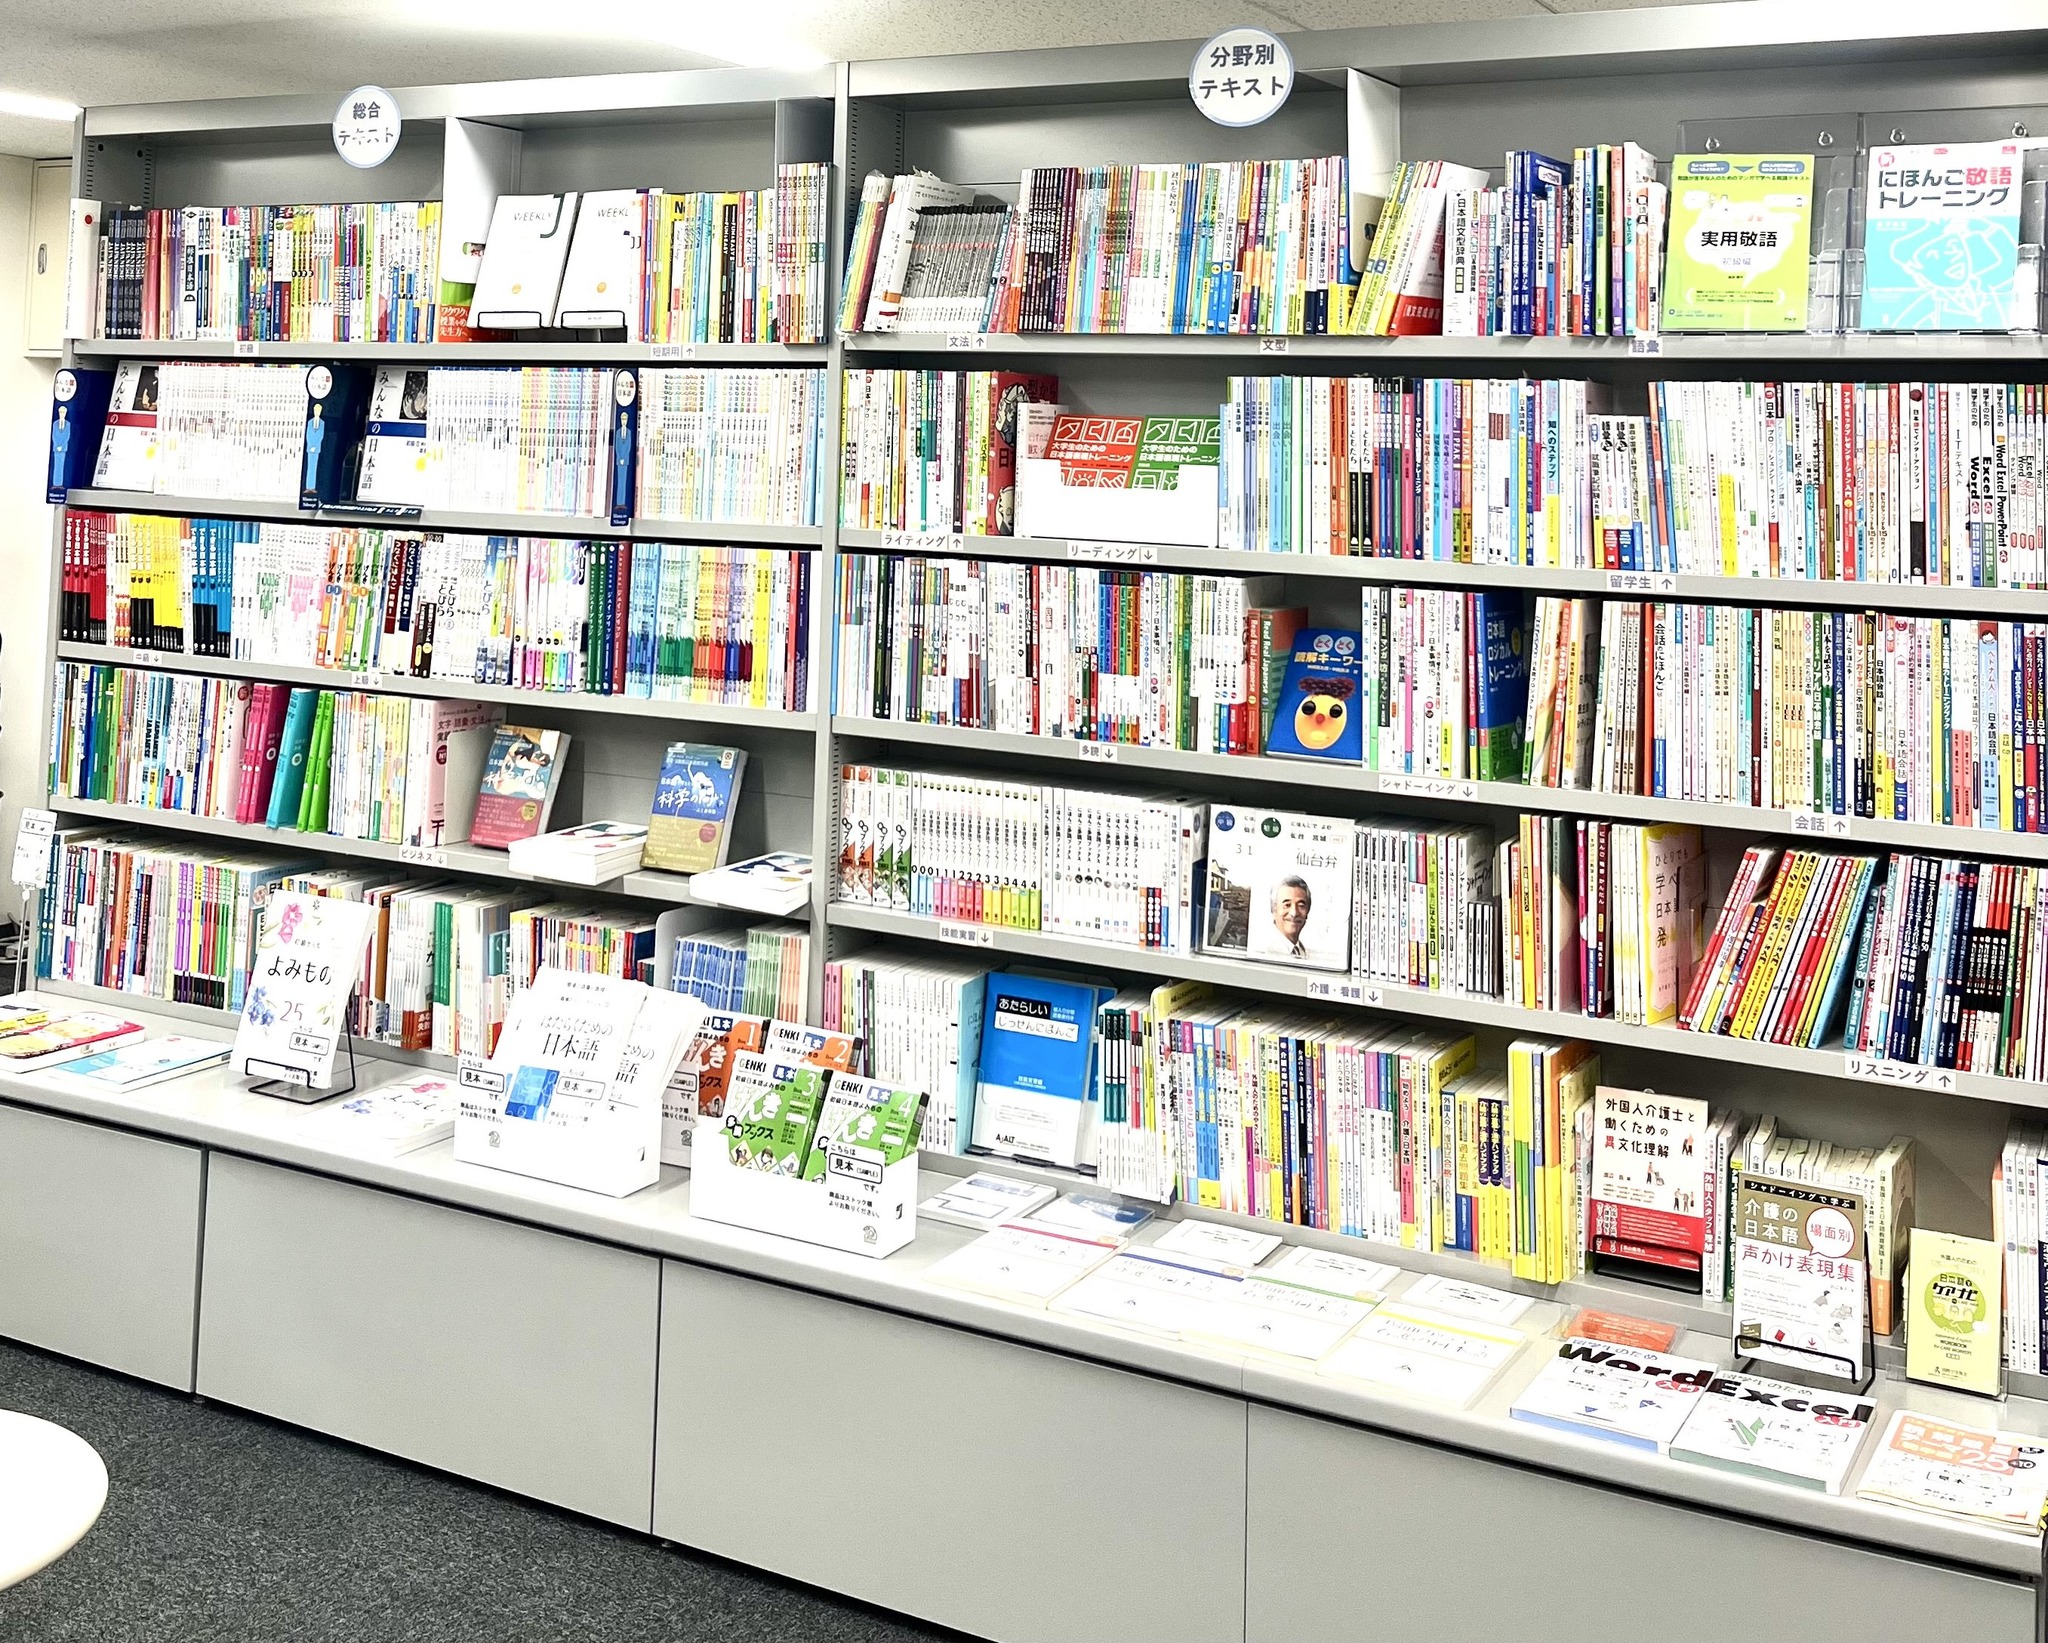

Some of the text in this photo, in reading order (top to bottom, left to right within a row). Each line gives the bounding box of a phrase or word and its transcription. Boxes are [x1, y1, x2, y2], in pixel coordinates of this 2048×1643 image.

[1209, 43, 1276, 69] 分野別
[1199, 76, 1284, 99] テキスト
[353, 101, 381, 120] 総合
[1878, 165, 2012, 188] にほんご敬語
[1878, 186, 2010, 209] トレーニング
[597, 207, 629, 218] WEEKL
[1701, 231, 1777, 248] 実用敬語
[949, 336, 969, 348] 文法
[1263, 339, 1286, 352] 文型
[1632, 339, 1659, 353] 語彙
[1996, 445, 2004, 465] Word
[1971, 456, 1980, 499] Word
[1982, 457, 1993, 499] Excel
[1998, 494, 2007, 547] PowerPoint
[885, 536, 946, 548] ライティング
[1071, 545, 1137, 561] リーディング
[1610, 575, 1651, 589] 留学生
[1487, 620, 1505, 639] 日本語
[1487, 646, 1511, 662] ロジカル
[1249, 655, 1258, 693] Japanese
[1262, 655, 1270, 694] Japanese
[1488, 660, 1523, 684] トレーニング
[1082, 745, 1099, 758] 多読
[1381, 779, 1456, 795] シャドーイング
[1795, 816, 1826, 832] 会話
[400, 849, 433, 862] ビジネス
[1296, 853, 1338, 869] 仙台弁
[1655, 849, 1689, 866] ひとりでも
[911, 865, 917, 873] 0
[920, 866, 926, 874] 0
[928, 867, 933, 875] 0
[936, 868, 939, 877] 1
[945, 869, 948, 878] 1
[952, 870, 956, 878] 1
[959, 871, 964, 879] 2
[967, 872, 972, 880] 2
[976, 873, 981, 882] 2
[985, 875, 990, 883] 3
[994, 876, 999, 884] 3
[1004, 877, 1009, 885] 3
[1012, 879, 1018, 887] 4
[1021, 880, 1026, 888] 4
[1031, 881, 1036, 889] 4
[942, 928, 976, 940] 技能実習
[268, 955, 332, 987] よみもの
[1309, 981, 1361, 1000] 介護・看護
[280, 1001, 304, 1022] 25
[998, 998, 1048, 1015] あたらしい
[773, 1027, 800, 1041] GENKI
[998, 1016, 1076, 1039] じっせんにほんご
[542, 1032, 600, 1062] 日本語
[835, 1041, 848, 1063] 2
[461, 1059, 483, 1068] こちらは
[739, 1056, 766, 1074] GENKI
[465, 1072, 482, 1083] 見本
[1850, 1060, 1929, 1085] リスニング
[802, 1072, 817, 1096] 3
[834, 1079, 864, 1094] GENKI
[898, 1094, 911, 1118] 4
[1606, 1098, 1695, 1123] 外国人介護士と
[1604, 1117, 1669, 1137] 働くための
[831, 1143, 856, 1155] こちらは
[1604, 1135, 1670, 1159] 異文化理解
[834, 1159, 854, 1172] 見本
[1750, 1182, 1851, 1208] シャドーイングで学ぶ
[1744, 1198, 1799, 1223] 介護の
[1743, 1219, 1799, 1245] 日本語
[1810, 1224, 1851, 1243] 場面別
[1742, 1243, 1855, 1283] 声かけ表現集
[1559, 1343, 1713, 1388] Word
[1705, 1379, 1876, 1423] Excel
